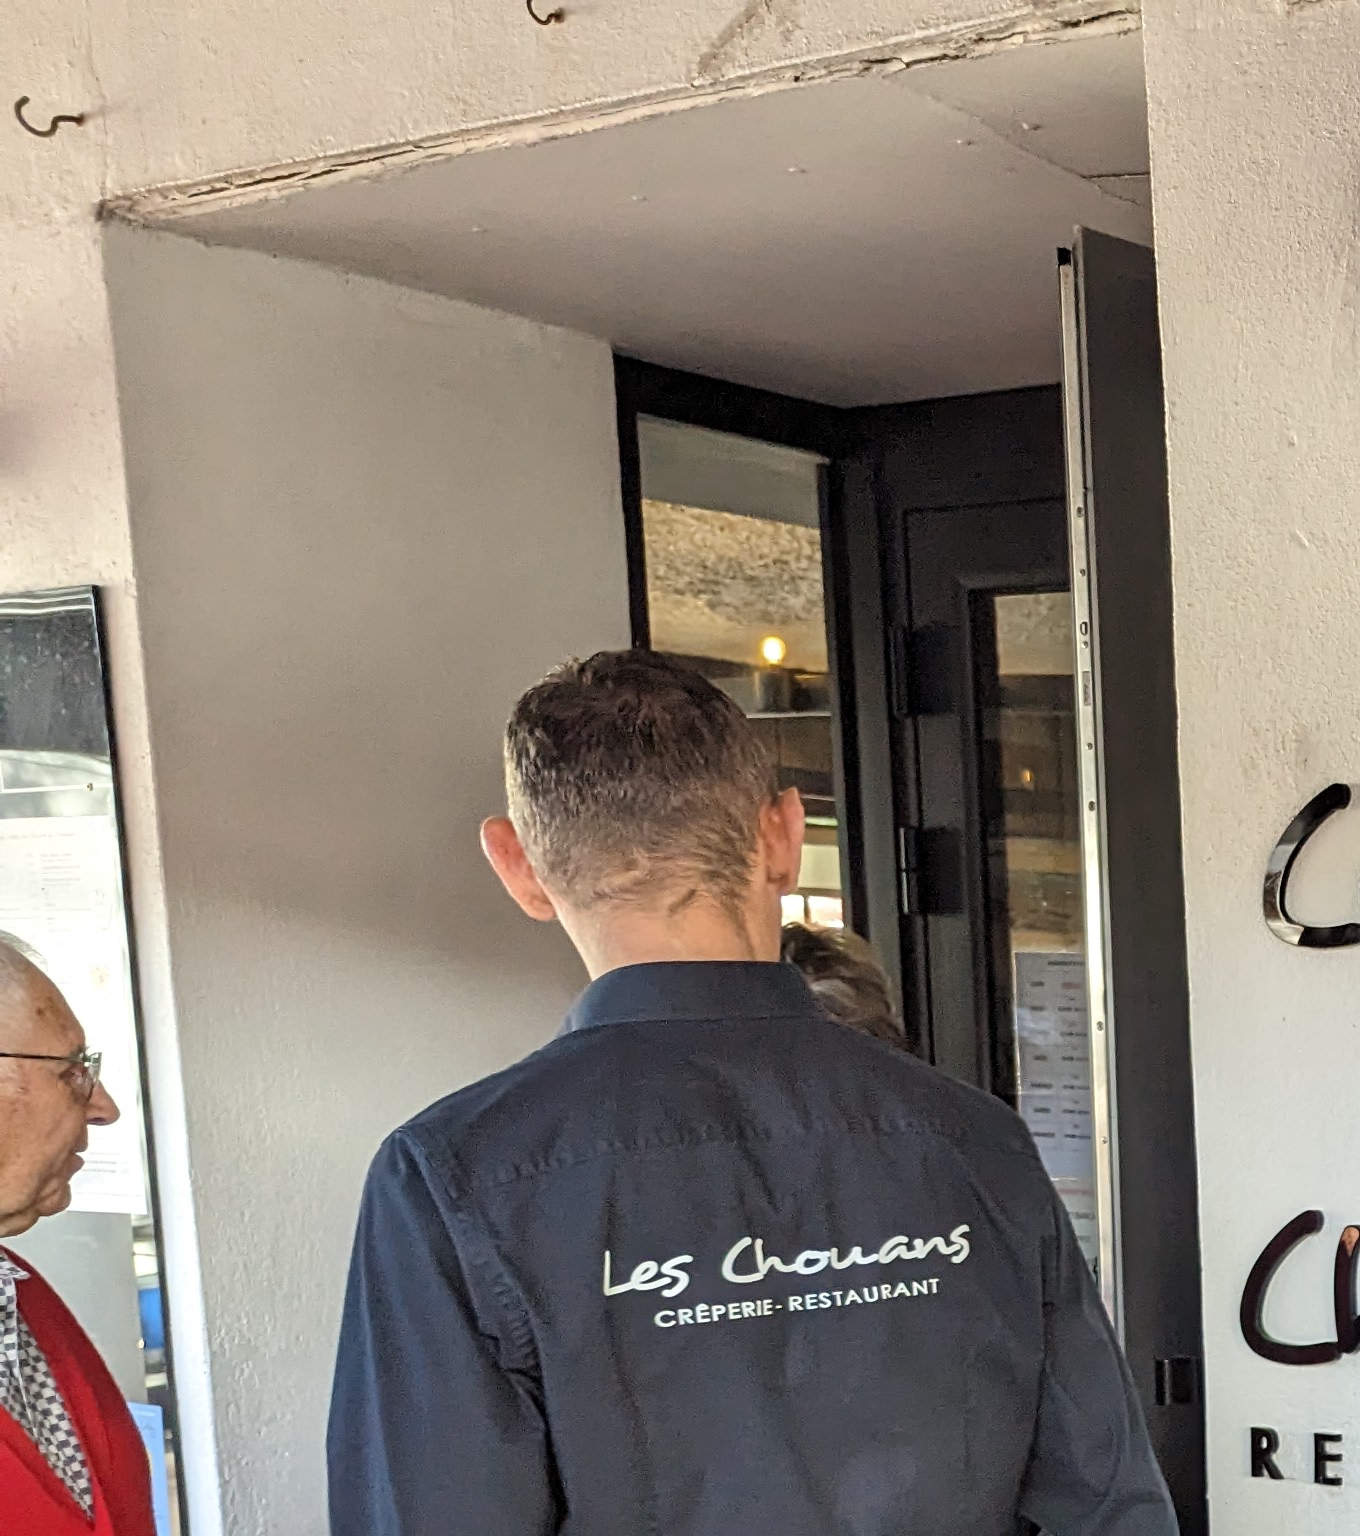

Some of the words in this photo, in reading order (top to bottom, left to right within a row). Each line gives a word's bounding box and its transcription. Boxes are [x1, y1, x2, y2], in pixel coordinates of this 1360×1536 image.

[603, 1250, 694, 1298] Les
[721, 1223, 971, 1284] Chouans
[788, 1278, 940, 1312] RESTAURANT
